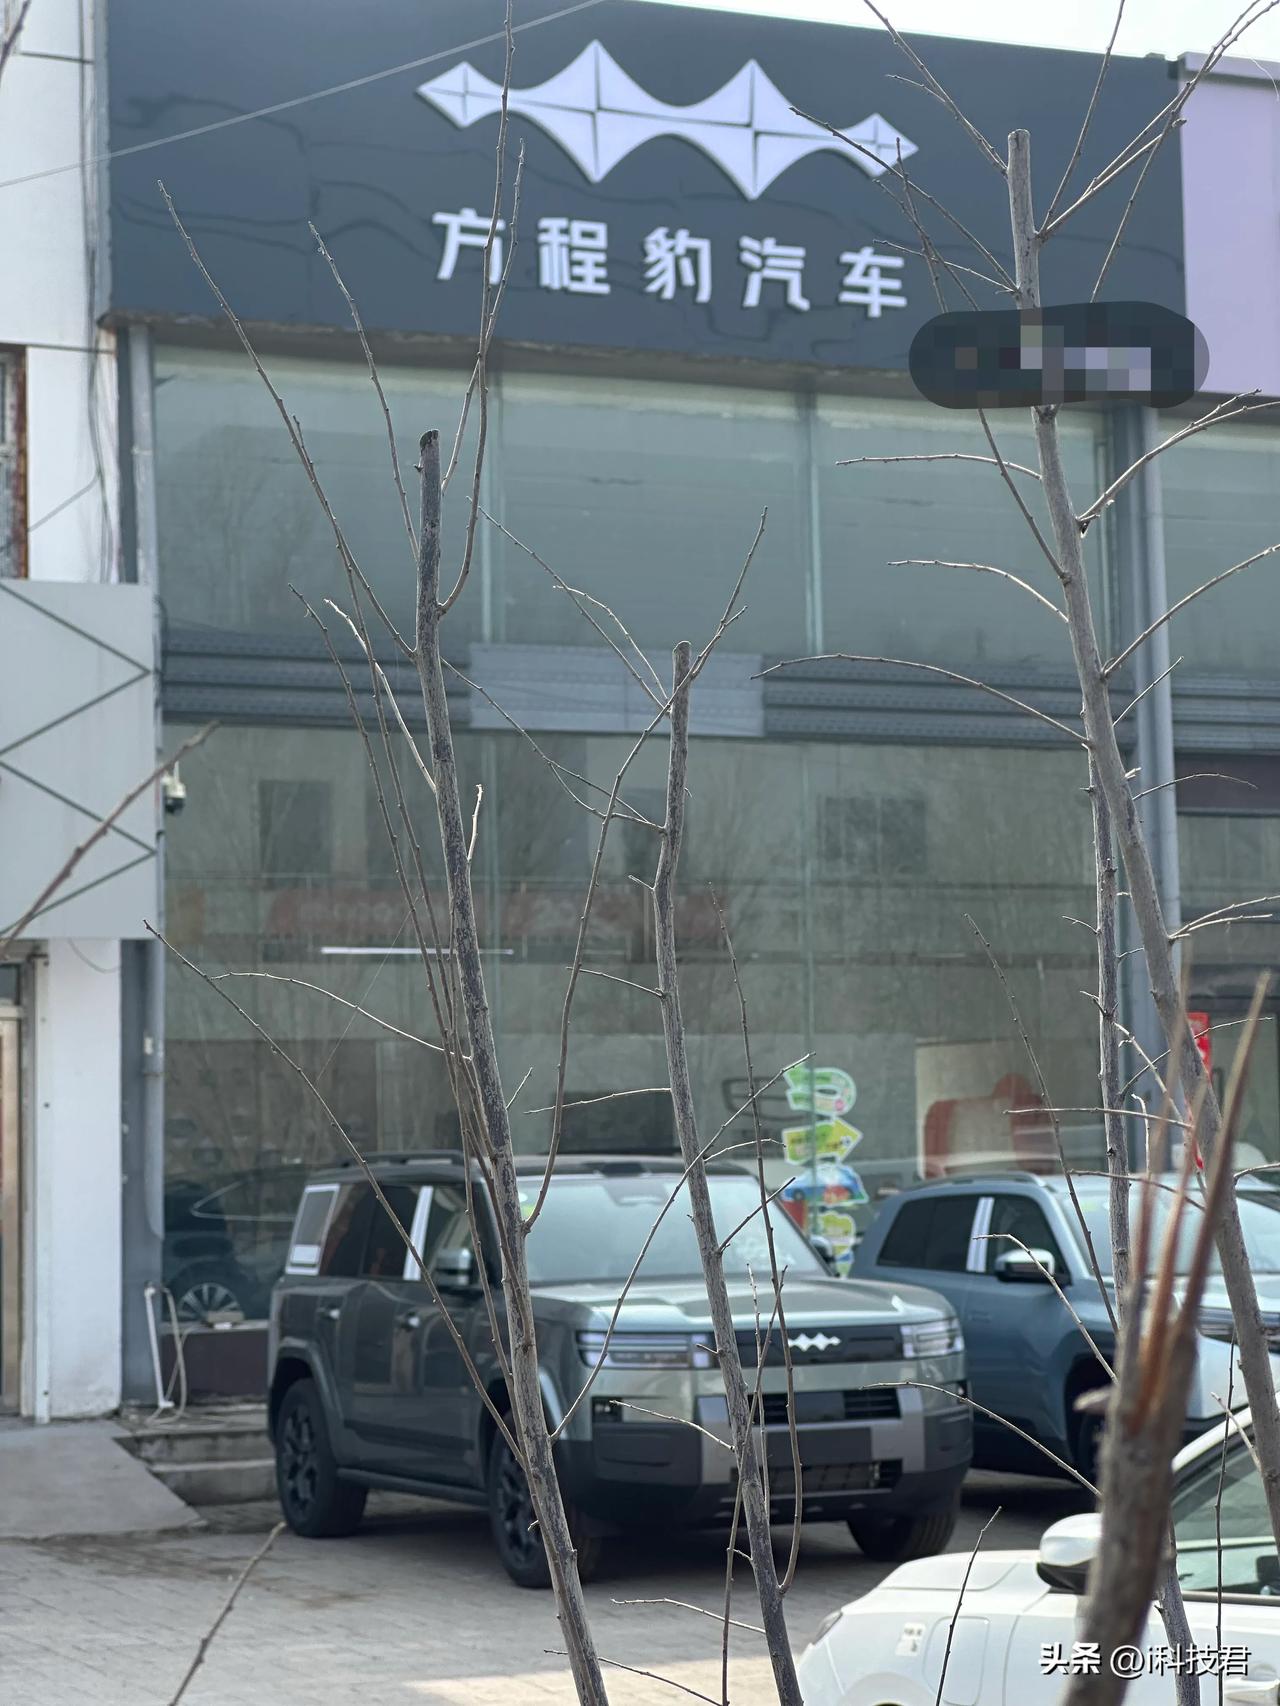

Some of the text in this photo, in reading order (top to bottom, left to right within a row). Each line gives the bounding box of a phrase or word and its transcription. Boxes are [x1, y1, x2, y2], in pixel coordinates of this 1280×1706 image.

[432, 208, 907, 317] 方程豹汽车
